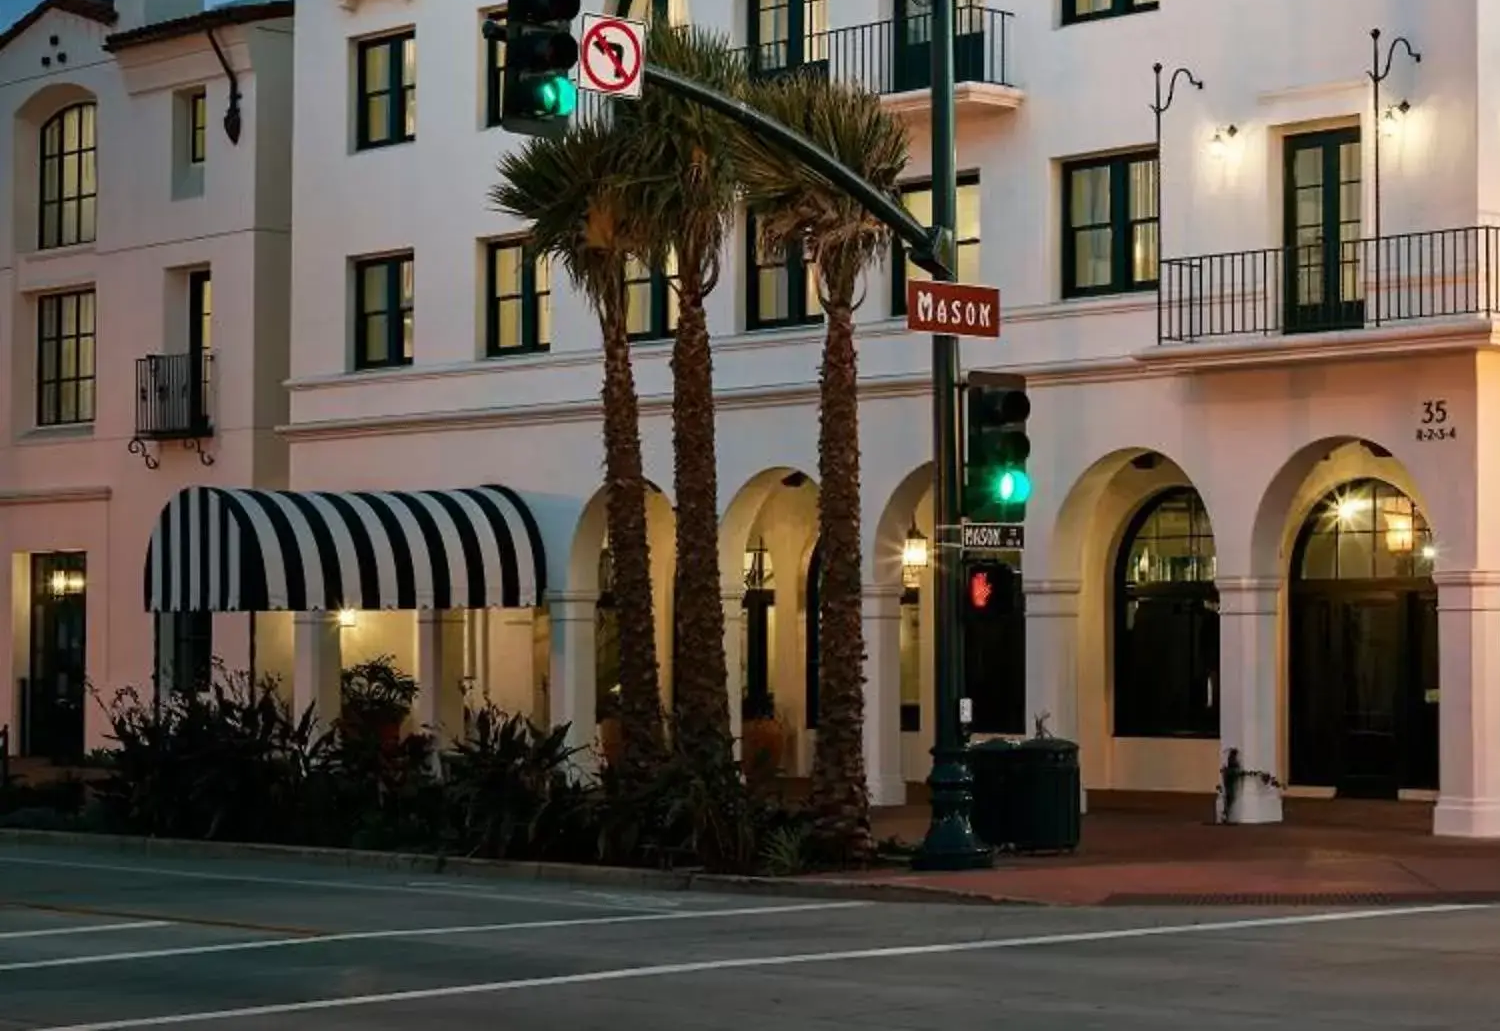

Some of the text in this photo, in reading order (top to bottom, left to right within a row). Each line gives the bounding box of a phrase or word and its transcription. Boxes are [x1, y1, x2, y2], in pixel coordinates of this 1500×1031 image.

[917, 290, 992, 328] MASON
[1422, 400, 1447, 424] 35
[965, 526, 1001, 546] MASON
